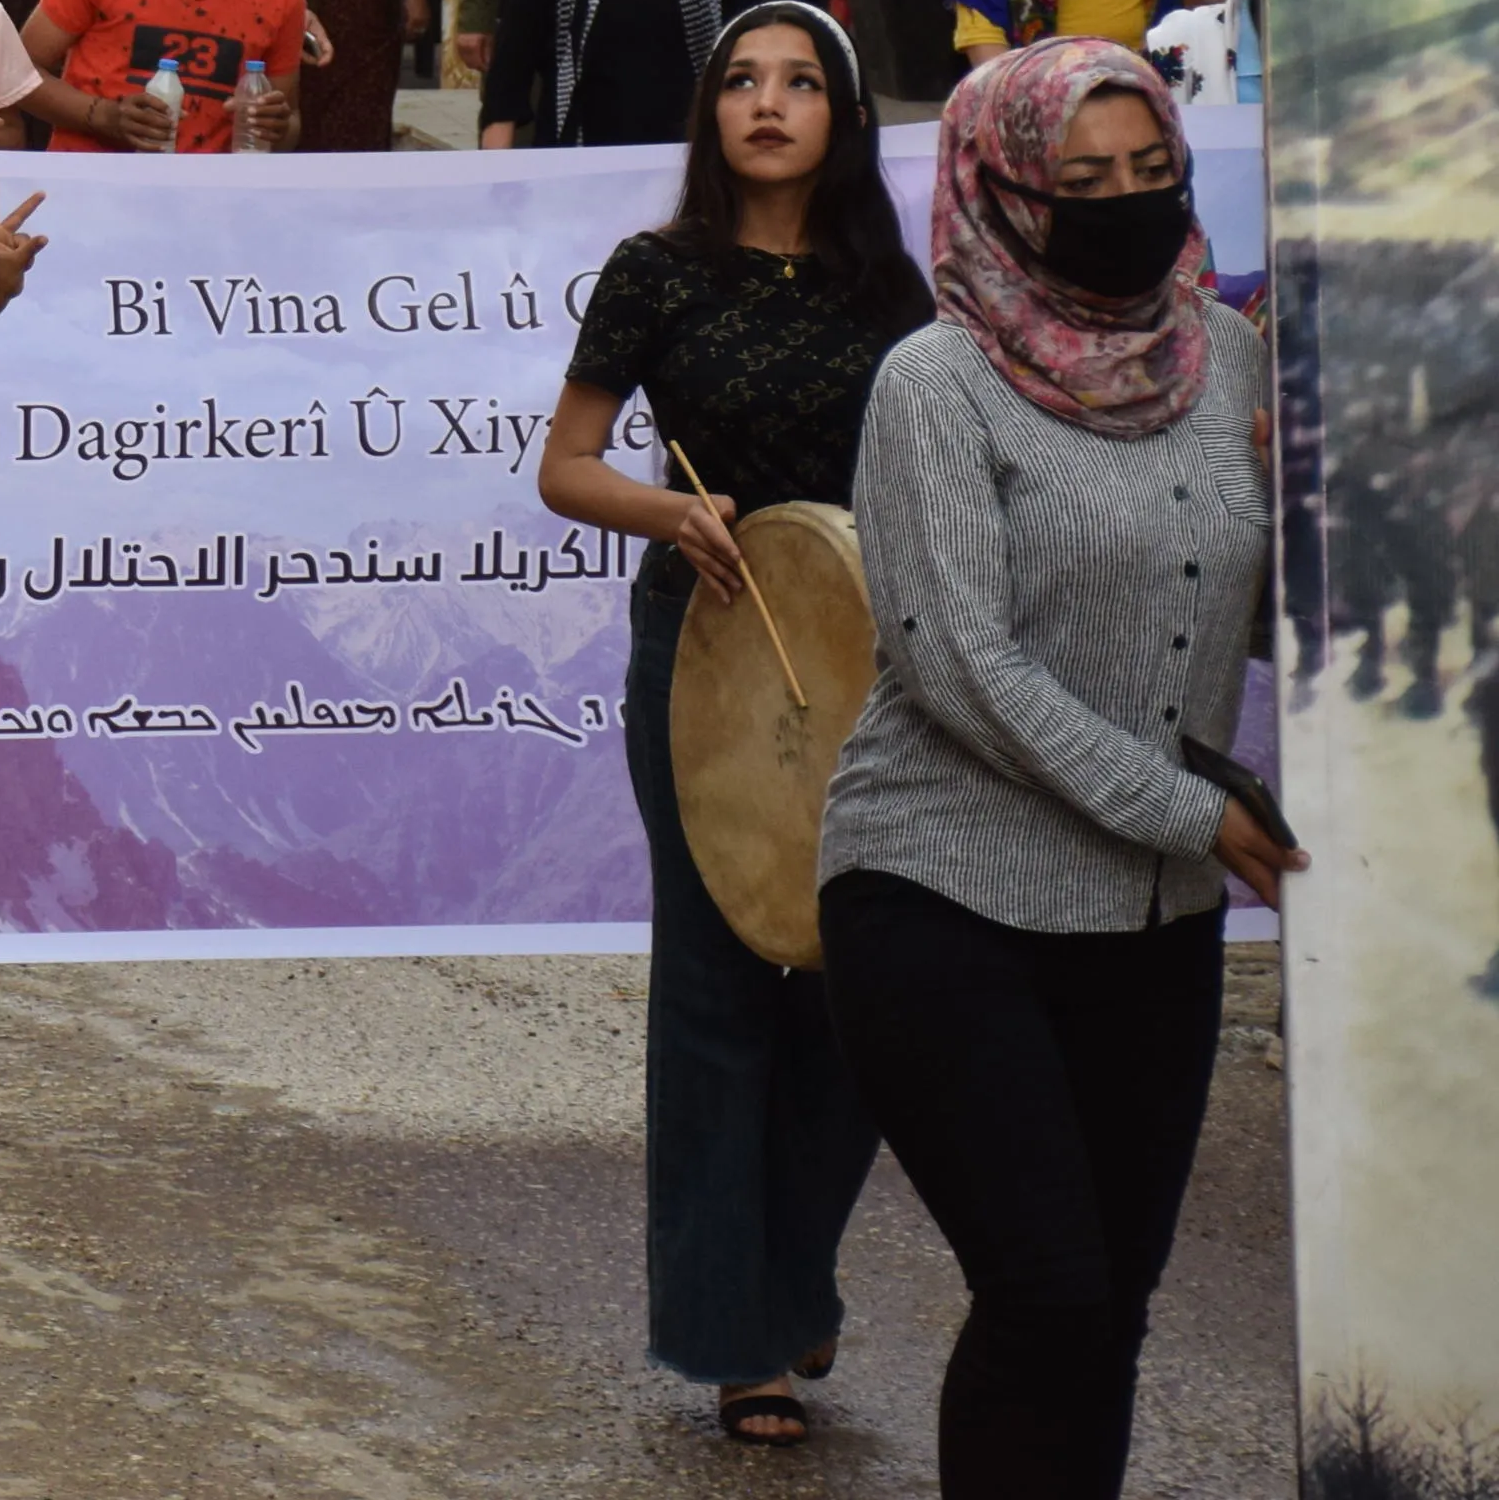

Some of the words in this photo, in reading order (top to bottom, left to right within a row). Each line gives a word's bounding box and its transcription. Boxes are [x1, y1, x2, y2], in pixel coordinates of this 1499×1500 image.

[162, 33, 220, 77] 23
[103, 277, 173, 336] Bi
[189, 275, 348, 336] Vîna
[367, 270, 482, 333] Gel
[500, 271, 544, 331] û
[14, 397, 330, 481] Dagirkerî
[349, 386, 407, 457] Û
[23, 532, 244, 601] الاحتلال
[257, 539, 442, 598] سندحر
[459, 527, 627, 592] الكريلا
